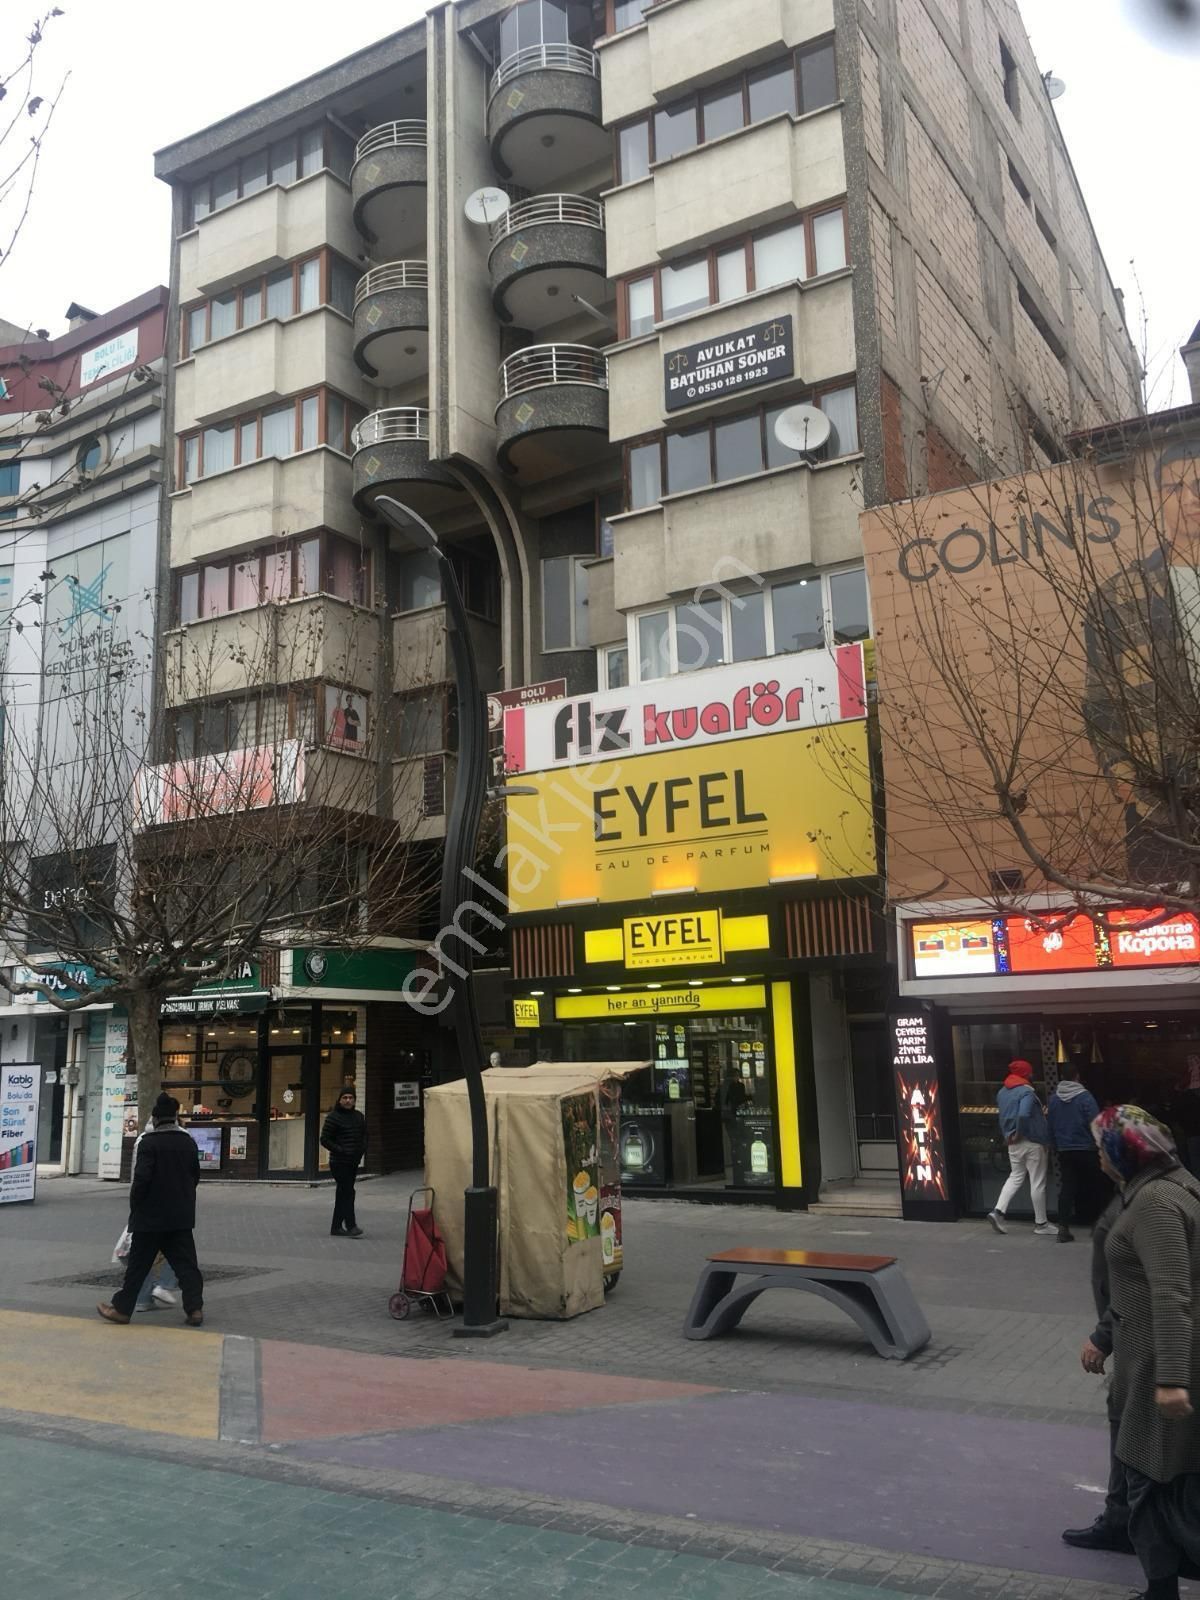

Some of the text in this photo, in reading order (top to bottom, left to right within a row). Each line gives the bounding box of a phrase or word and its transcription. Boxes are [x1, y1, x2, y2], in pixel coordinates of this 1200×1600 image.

[696, 334, 756, 363] AVUKAT
[670, 344, 786, 390] BATUHAN SONER
[698, 366, 769, 394] 0530 128 1923
[898, 495, 1121, 582] COLIN'S
[520, 686, 546, 699] BOLU
[643, 679, 804, 746] kuaför
[593, 769, 768, 842] EYFEL
[595, 844, 770, 871] EAU DE PARFUM
[631, 917, 711, 948] EYFEL
[1118, 935, 1196, 956] Корона
[515, 1003, 538, 1016] EYFEL
[607, 990, 700, 1012] her an yanında
[897, 1018, 923, 1026] GRAM
[897, 1037, 926, 1045] YARIM
[893, 1055, 934, 1064] ATA LİRA
[8, 1075, 33, 1084] Kablo
[1, 1130, 24, 1138] Fiber
[910, 1089, 932, 1181] ALTIN
